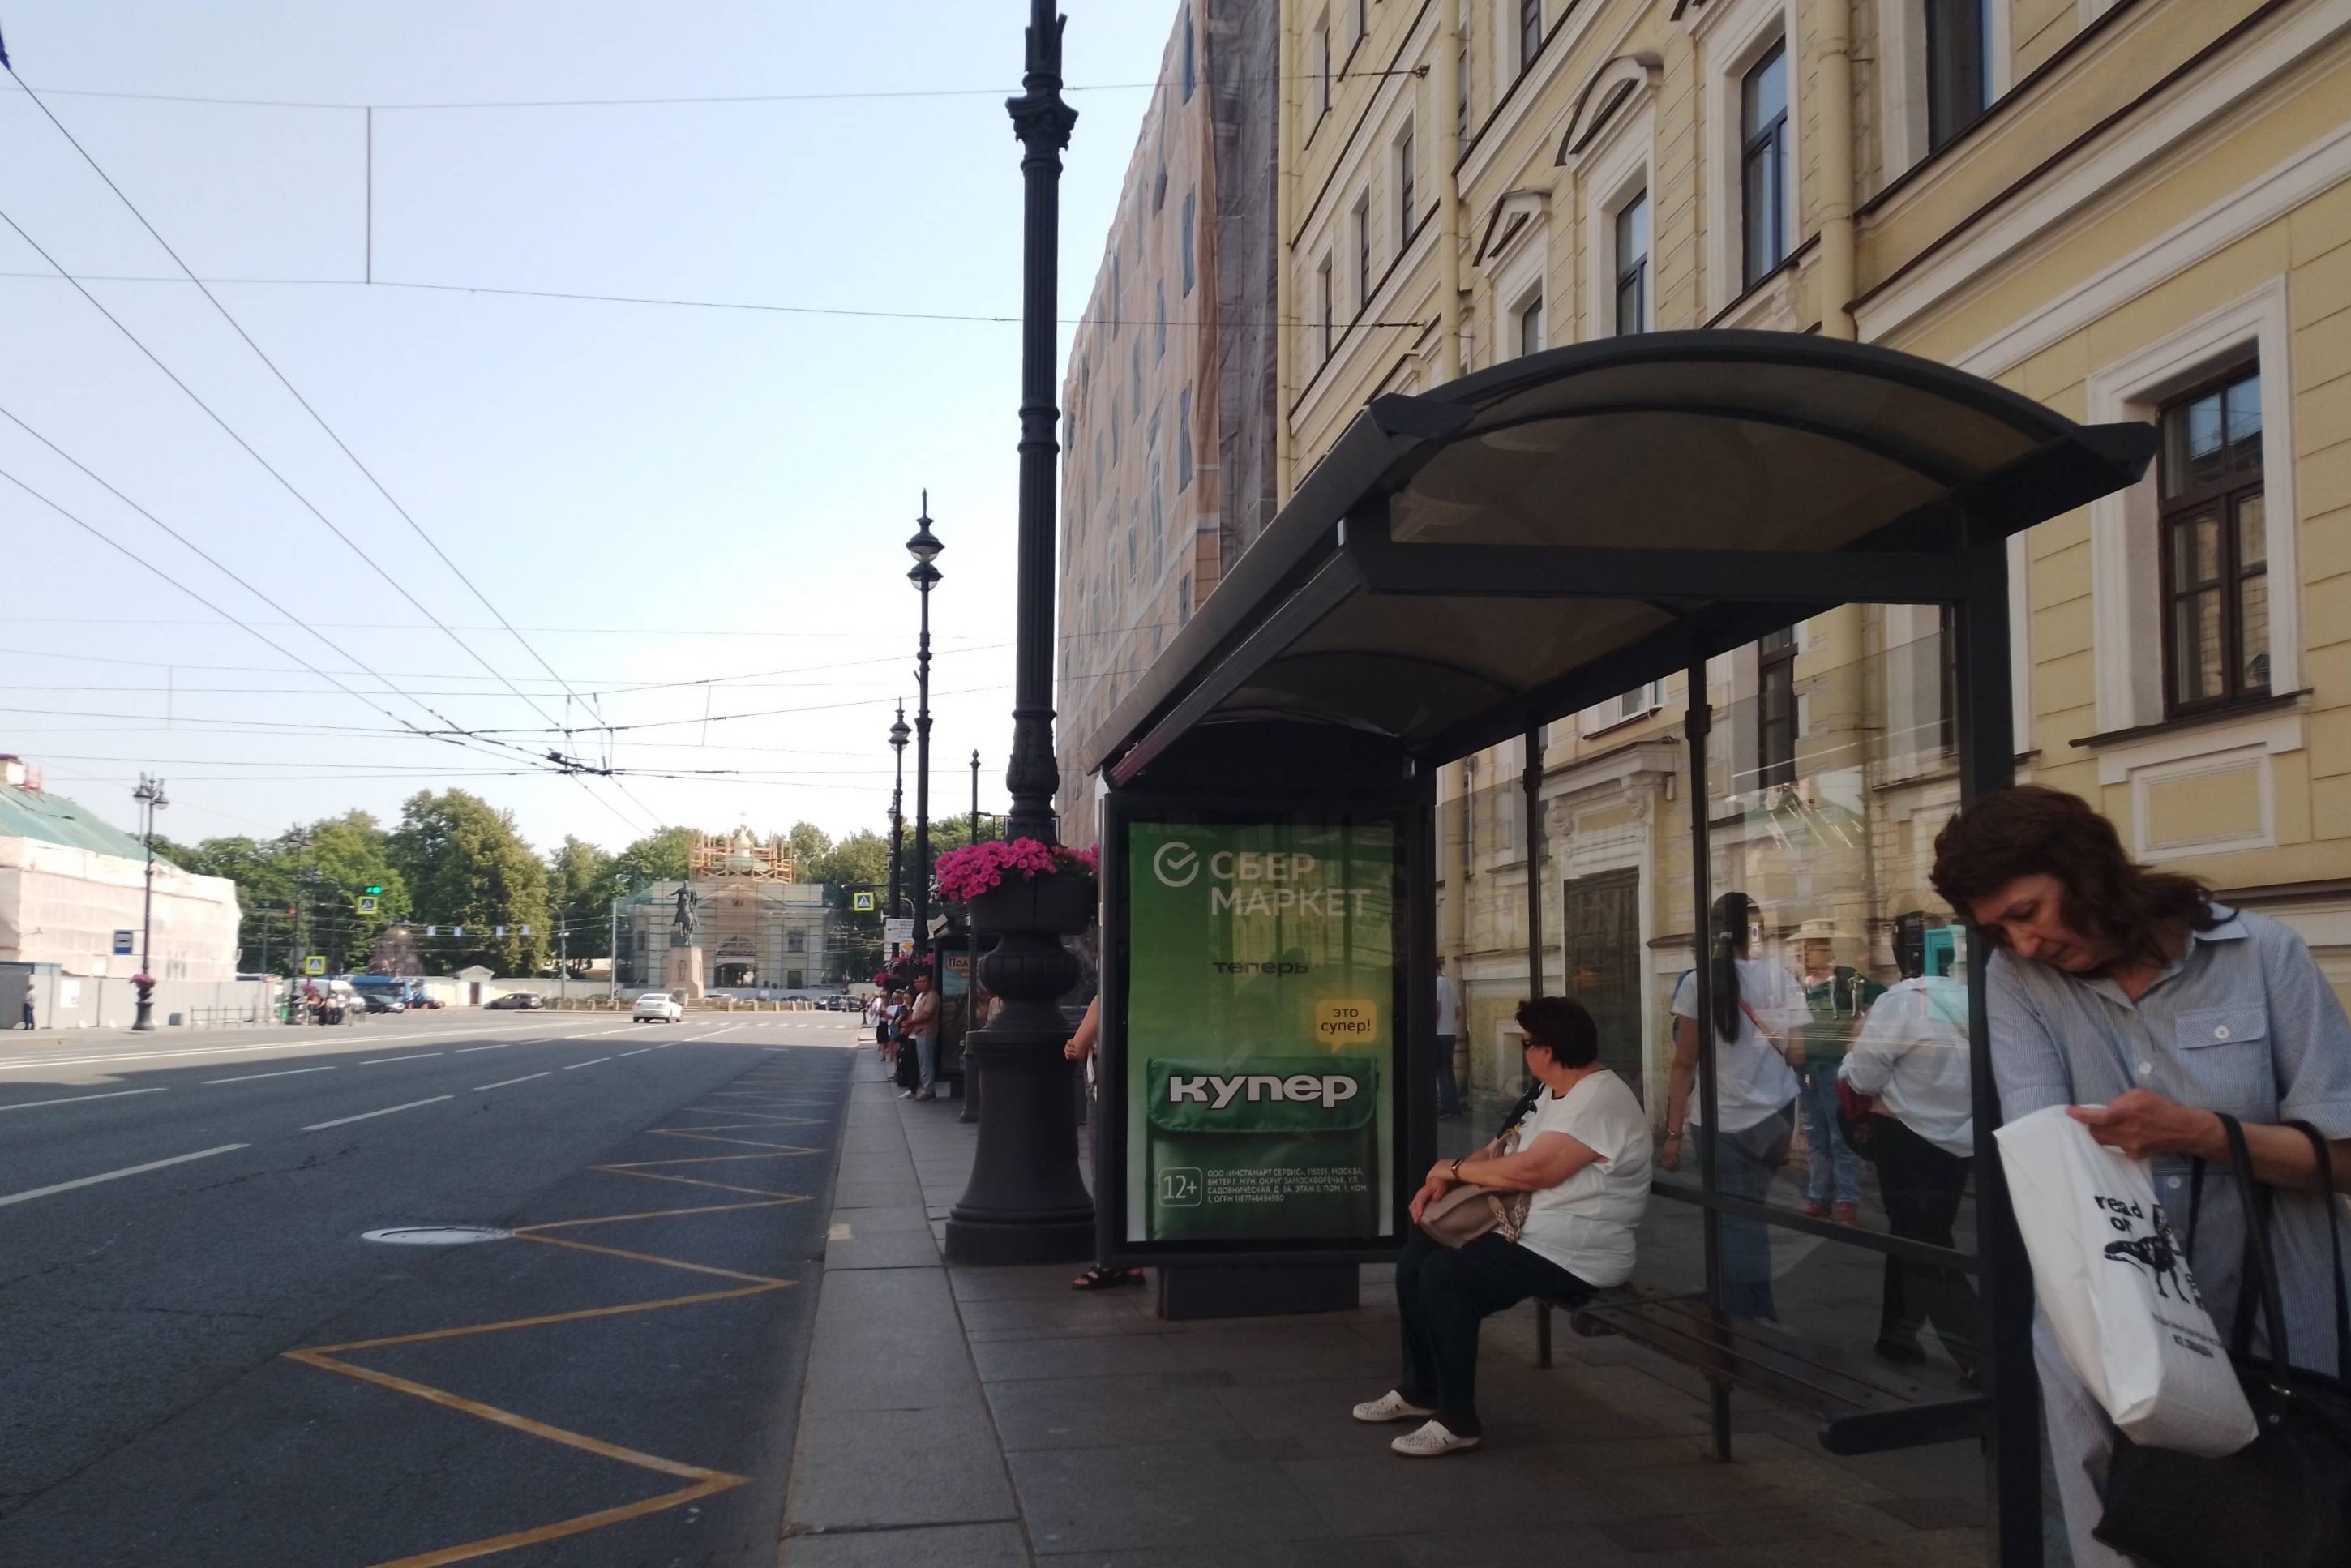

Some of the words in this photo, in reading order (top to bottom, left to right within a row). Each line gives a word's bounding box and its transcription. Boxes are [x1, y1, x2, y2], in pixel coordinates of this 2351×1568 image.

[1210, 850, 1316, 881] СБЕР
[1210, 887, 1372, 917] МАРКЕТ
[1212, 962, 1309, 977] теперь
[1333, 1008, 1359, 1018] это
[1321, 1019, 1371, 1035] супер!
[1169, 1074, 1359, 1109] купер
[1207, 1169, 1224, 1177] ООО
[1163, 1174, 1197, 1199] 12+
[2094, 1194, 2145, 1220] read
